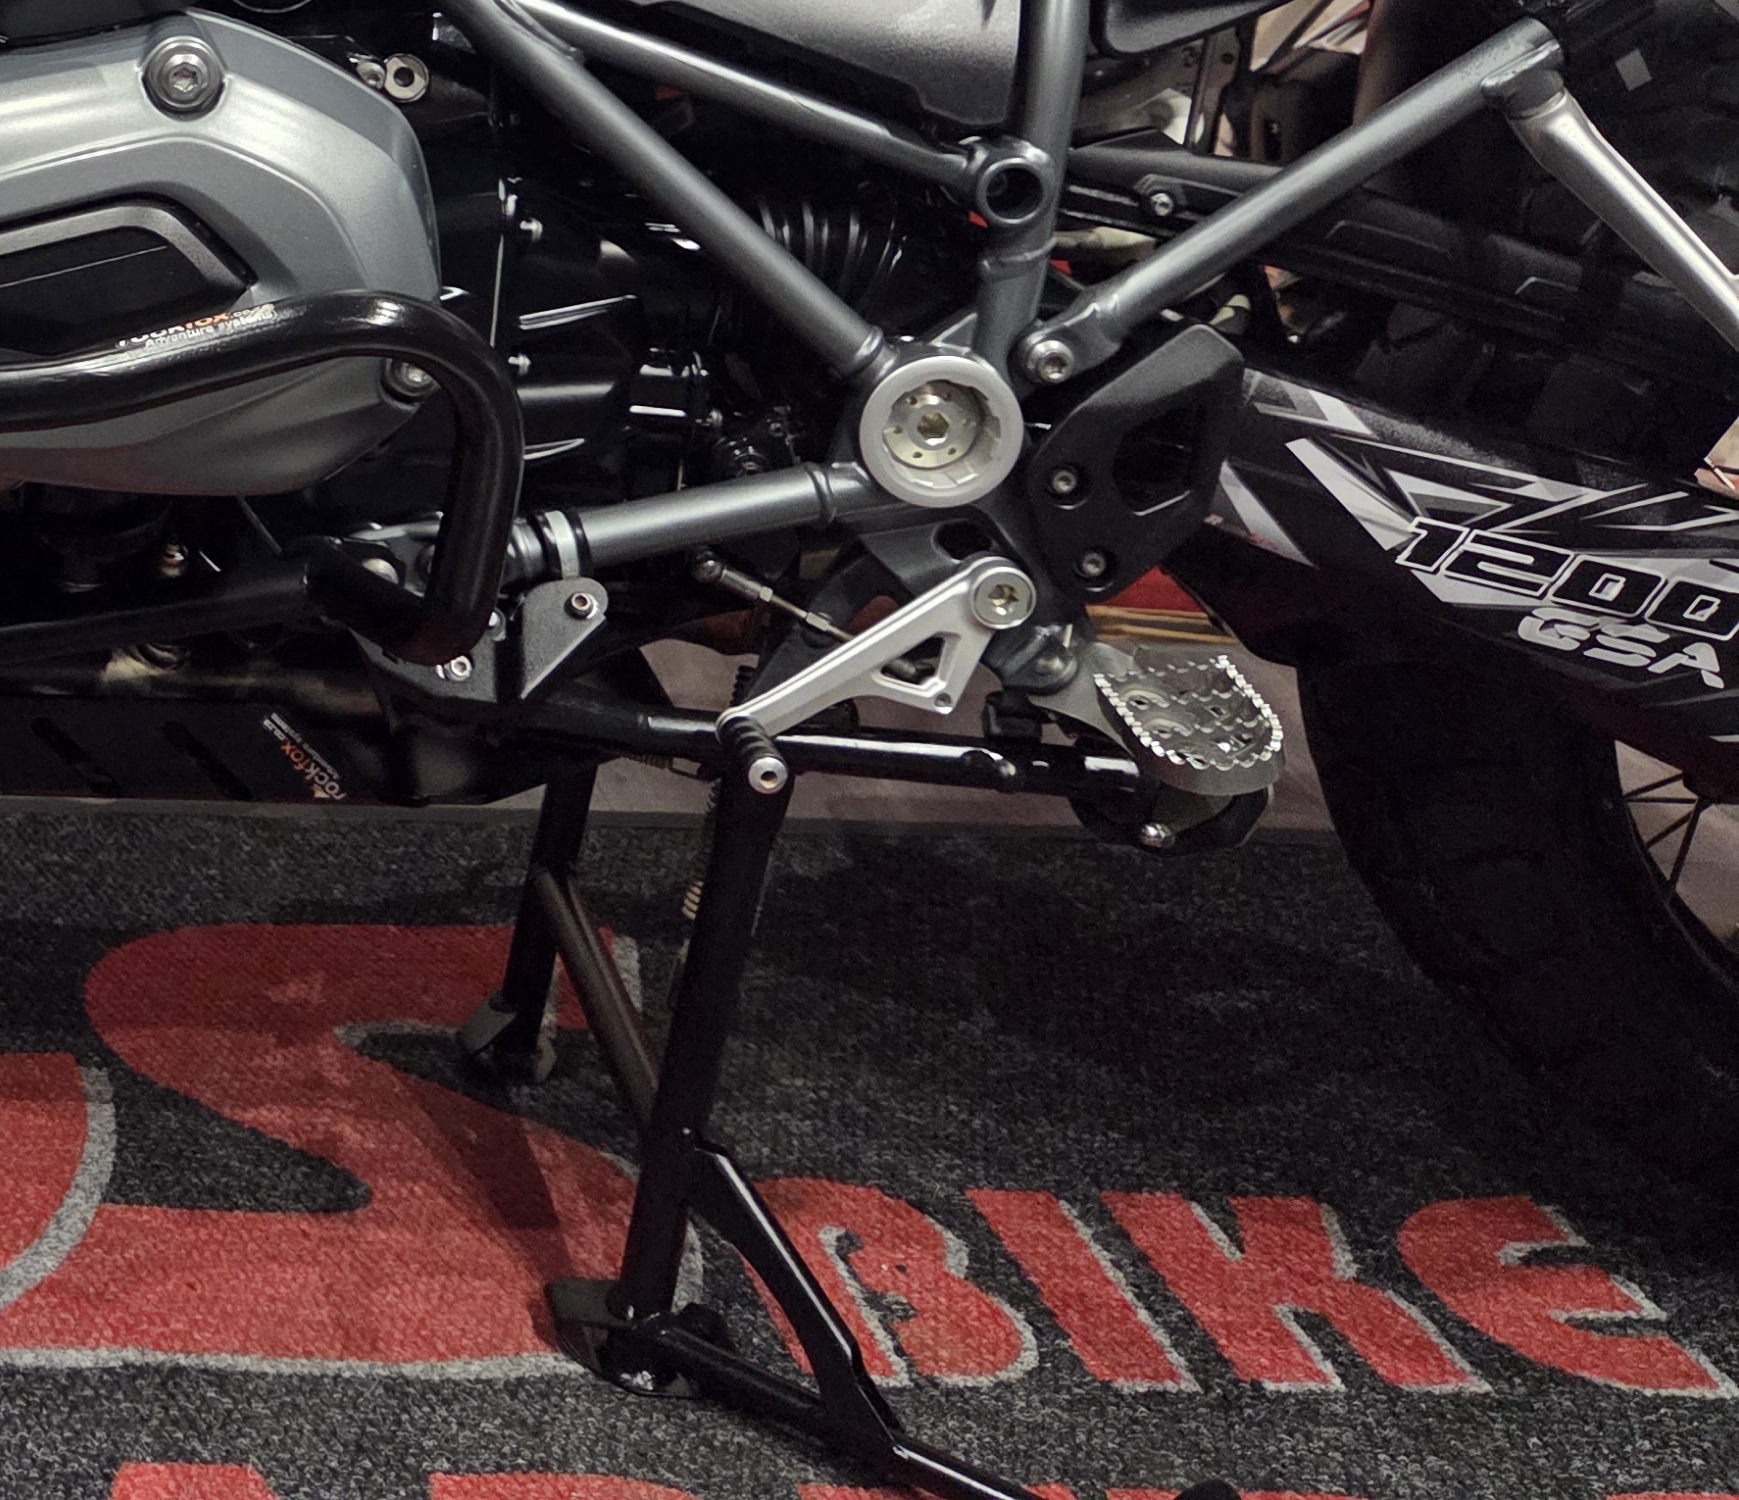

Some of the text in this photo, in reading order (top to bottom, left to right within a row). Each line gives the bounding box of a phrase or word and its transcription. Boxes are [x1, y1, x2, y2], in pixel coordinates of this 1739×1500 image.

[1395, 517, 1739, 641] 1200
[1517, 606, 1724, 689] GSA
[734, 1178, 1735, 1399] BIKE
